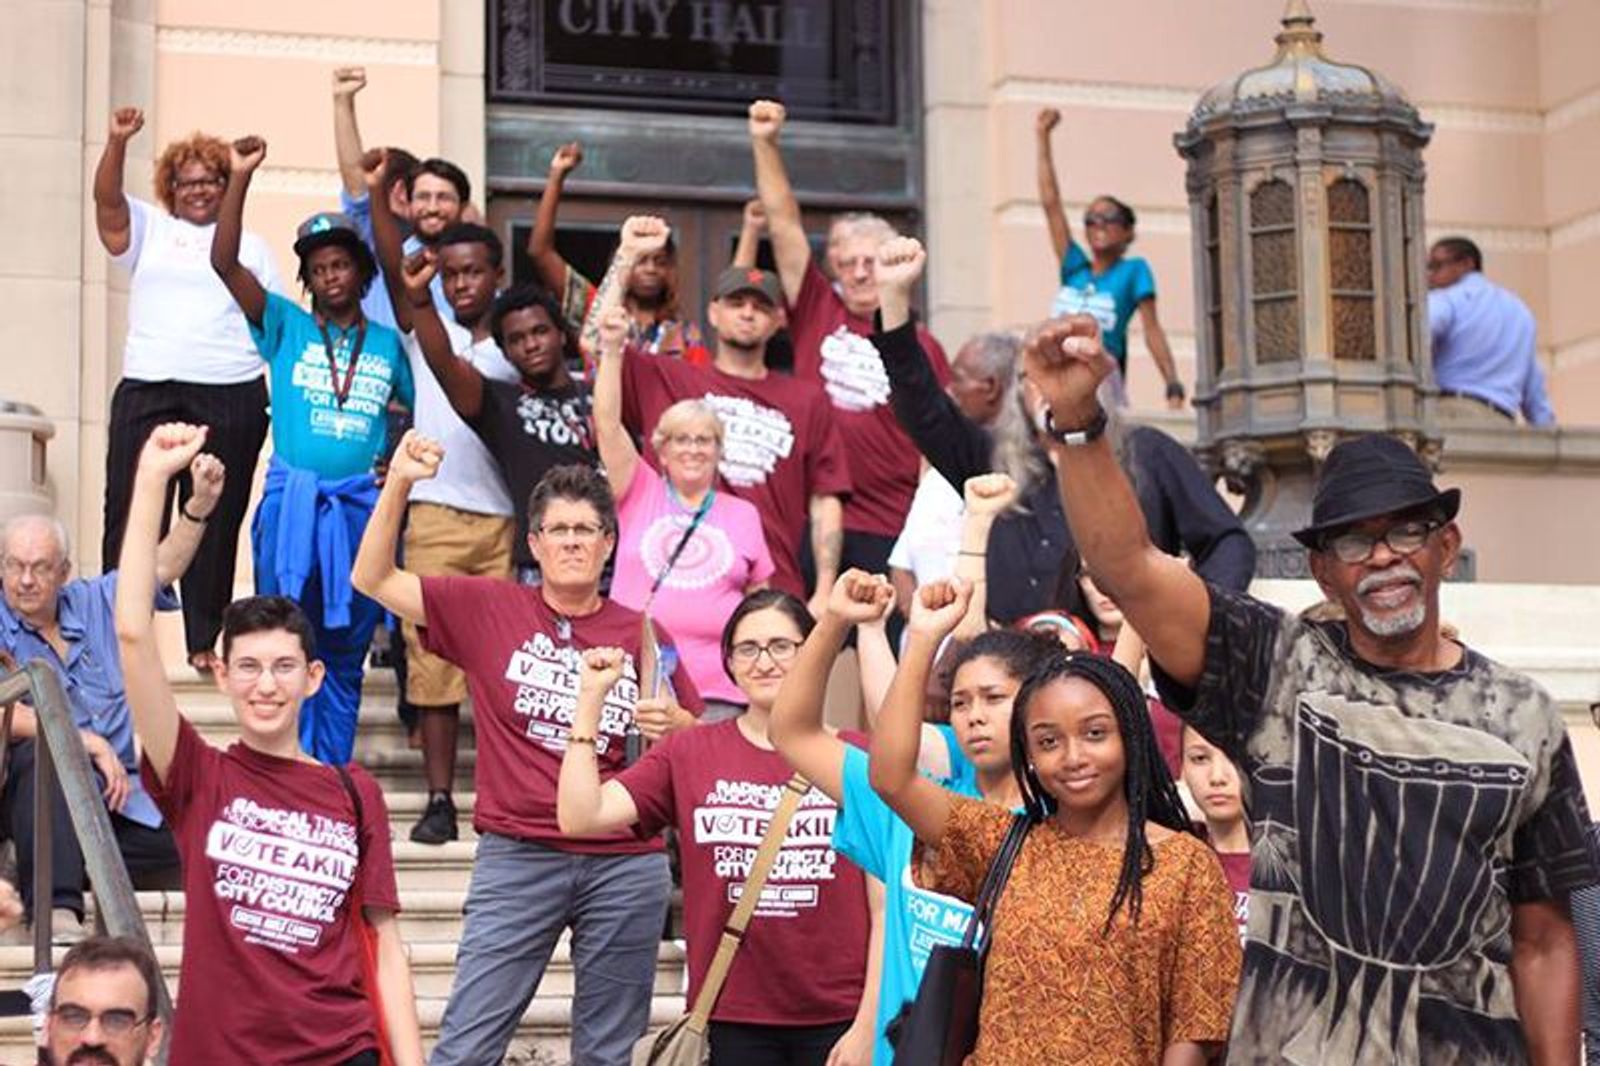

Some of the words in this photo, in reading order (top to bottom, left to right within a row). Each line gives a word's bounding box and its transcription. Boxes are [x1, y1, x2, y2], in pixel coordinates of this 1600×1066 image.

[559, 0, 675, 39] CITY
[701, 814, 769, 838] VOTE
[220, 830, 290, 867] VOTE
[714, 845, 743, 863] FOR
[768, 862, 836, 880] OUNCIL
[213, 879, 262, 905] CITY
[217, 863, 253, 889] FOR
[253, 873, 336, 907] DISTRICT
